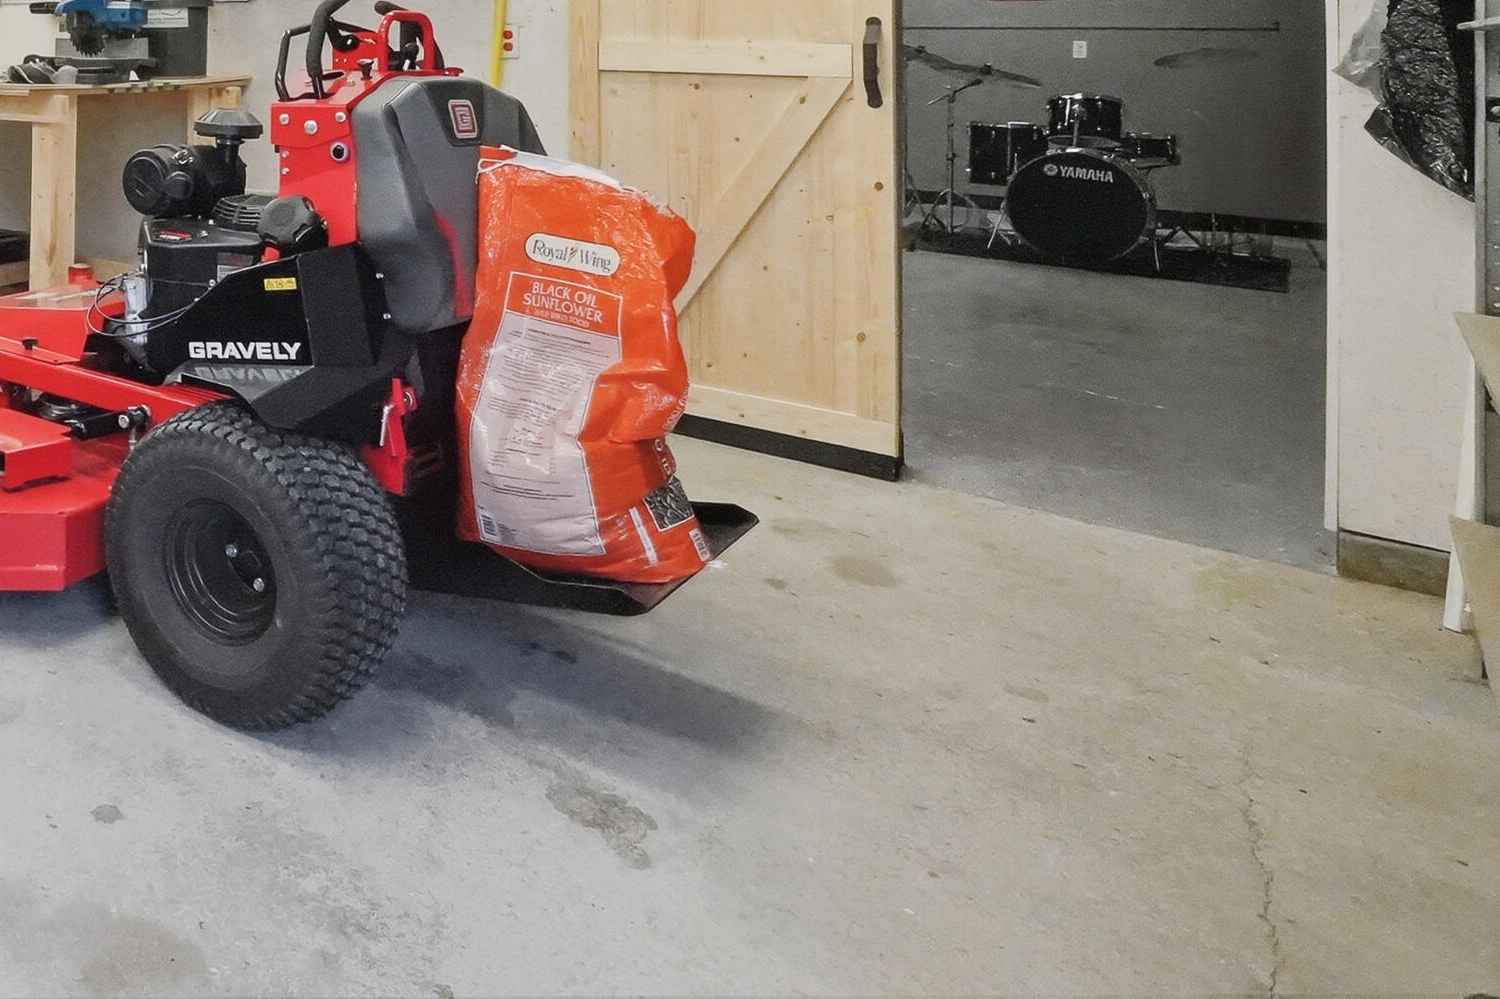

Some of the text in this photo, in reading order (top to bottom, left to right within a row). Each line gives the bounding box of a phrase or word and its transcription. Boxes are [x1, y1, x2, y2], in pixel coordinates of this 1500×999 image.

[1060, 165, 1113, 183] YAMAHA
[532, 239, 611, 273] Royal Wing
[522, 293, 603, 323] SUNFLOWER
[532, 281, 598, 308] BLACK OIL
[188, 341, 301, 360] GRAVELY
